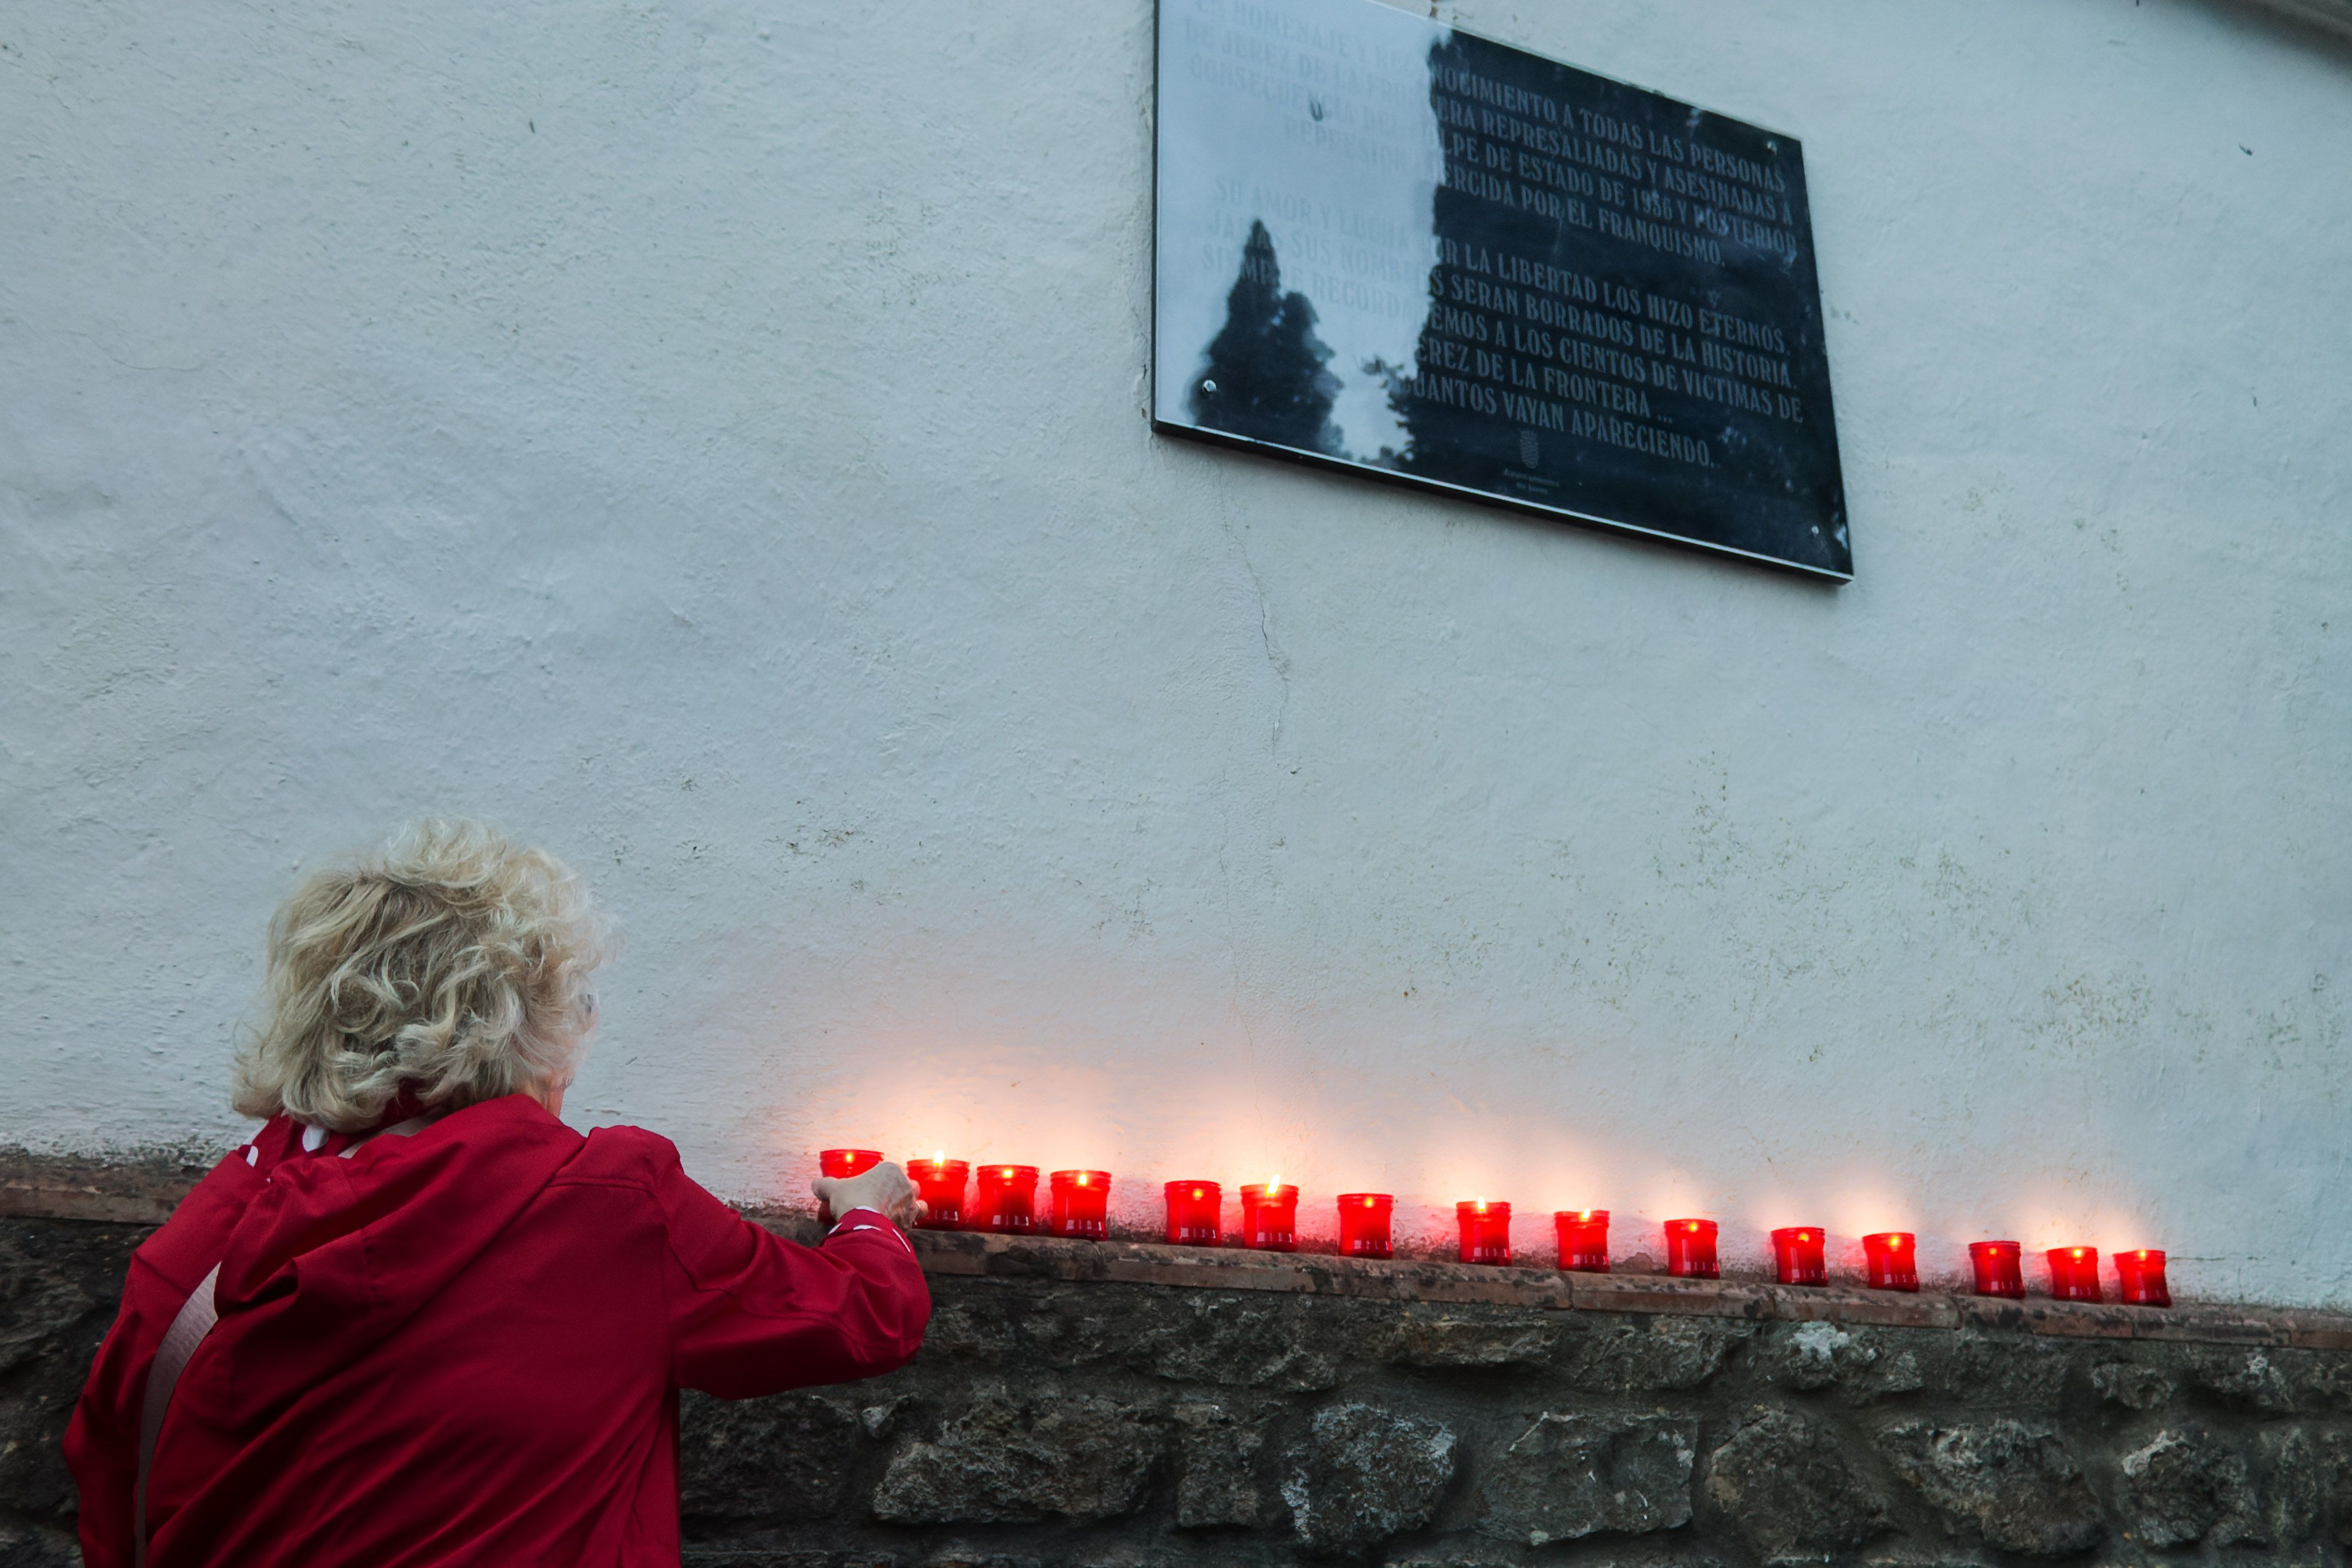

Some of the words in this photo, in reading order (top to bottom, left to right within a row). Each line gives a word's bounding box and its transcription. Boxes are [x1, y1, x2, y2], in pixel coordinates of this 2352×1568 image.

[1482, 109, 1642, 180] REPRESALIADAS
[1647, 159, 1658, 185] Y
[1665, 165, 1777, 221] ASESINADAS
[1782, 201, 1793, 226] A
[1563, 103, 1575, 130] A
[1579, 108, 1643, 149] TODAS
[1649, 130, 1684, 163] LAS
[1690, 142, 1785, 193] PERSONAS
[1485, 142, 1512, 172] DE
[1518, 151, 1594, 197] ESTADO
[1599, 176, 1626, 207] DE
[1677, 199, 1687, 225] Y
[1693, 205, 1797, 263] POSTERIOR
[1521, 184, 1565, 220] POR
[1566, 198, 1593, 228] EL
[1598, 207, 1726, 268] FRANQUISMO.
[1450, 273, 1519, 316] SERAN
[1525, 293, 1635, 346] BORRADOS
[1640, 323, 1666, 355] DE
[1671, 332, 1696, 363] LA
[1701, 340, 1799, 390] HISTORIA.
[1465, 242, 1492, 275] LA
[1497, 252, 1598, 303] LIBERTAD
[1603, 281, 1642, 315] LOS
[1648, 293, 1693, 330] HIZO
[1699, 307, 1792, 356] ETERNOS.
[1476, 349, 1505, 383] DE
[1511, 357, 1538, 391] LA
[1543, 366, 1651, 419] FRONTERA
[1495, 320, 1508, 348] A
[1514, 324, 1553, 359] LOS
[1559, 336, 1646, 383] CIENTOS
[1652, 360, 1679, 391] DE
[1682, 367, 1774, 416] VICTIMAS
[1778, 392, 1805, 424] DE
[1502, 390, 1565, 433] VAYAN
